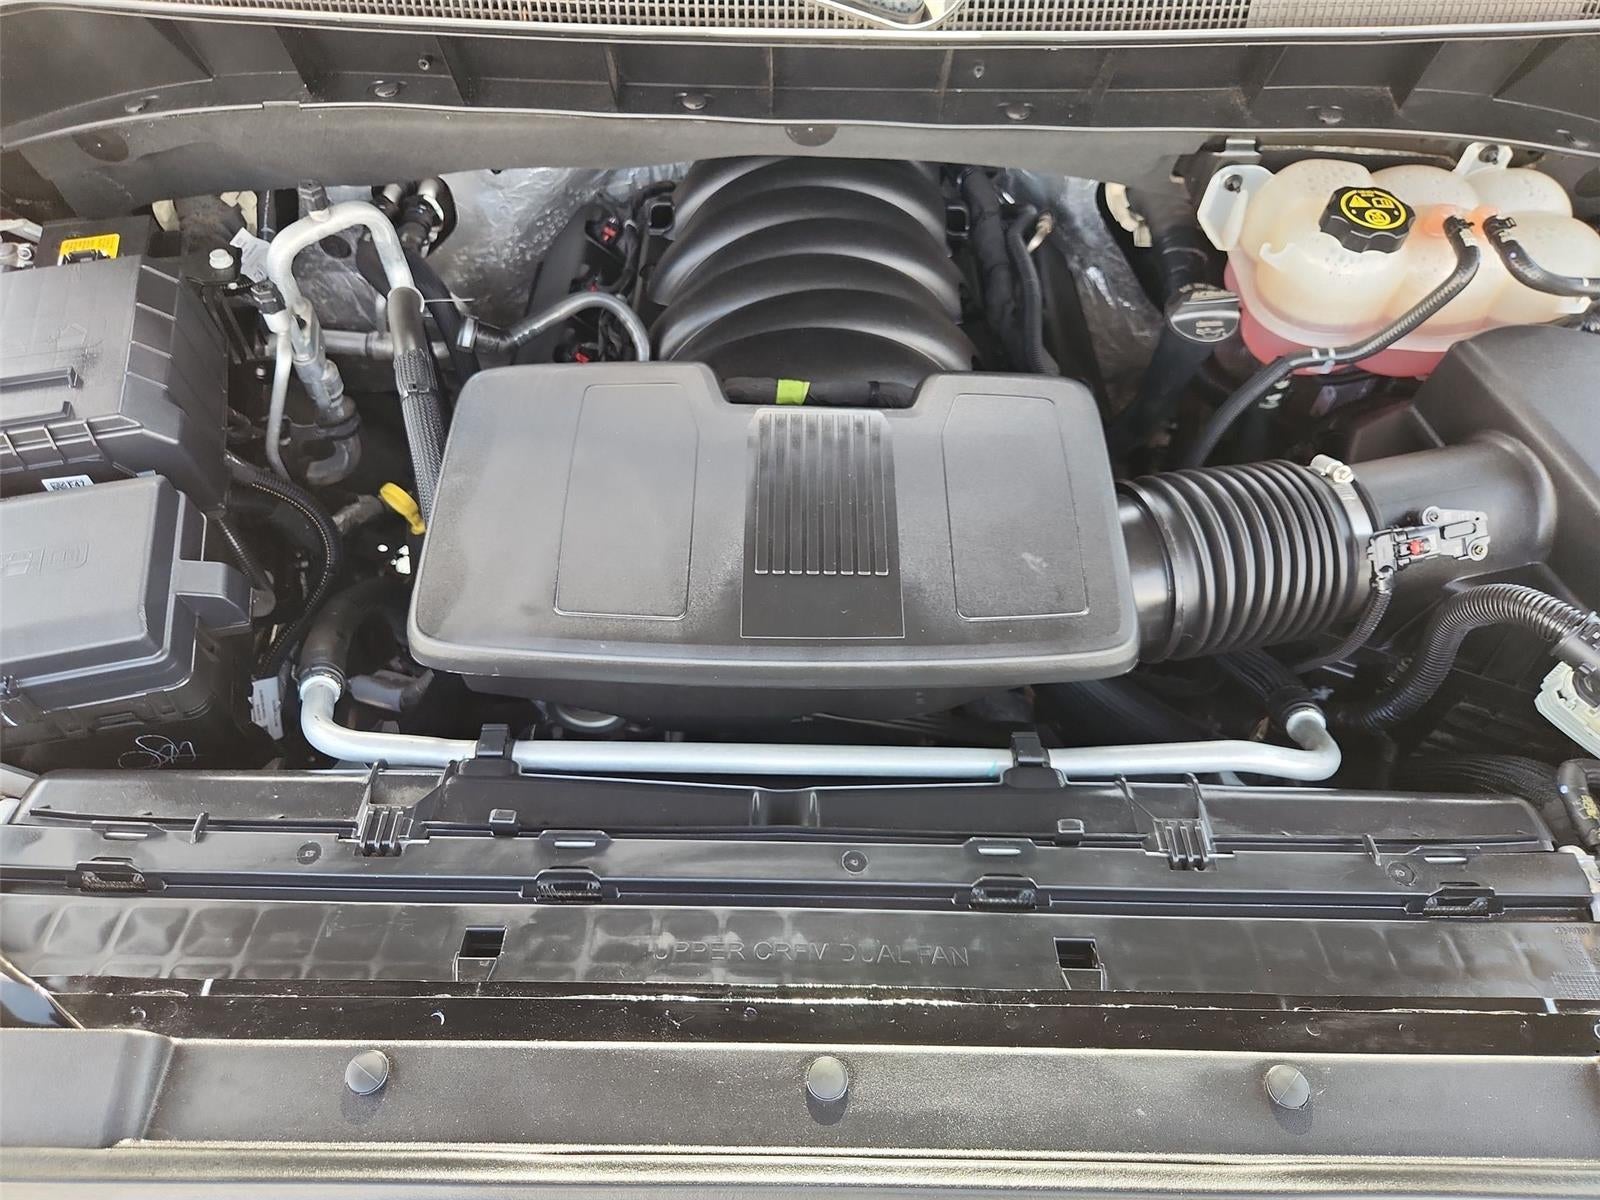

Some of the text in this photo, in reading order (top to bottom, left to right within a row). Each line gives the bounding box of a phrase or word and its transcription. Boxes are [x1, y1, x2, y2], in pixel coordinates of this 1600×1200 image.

[652, 940, 746, 961] UPPER
[838, 943, 912, 964] DUAL
[918, 945, 969, 967] FAN
